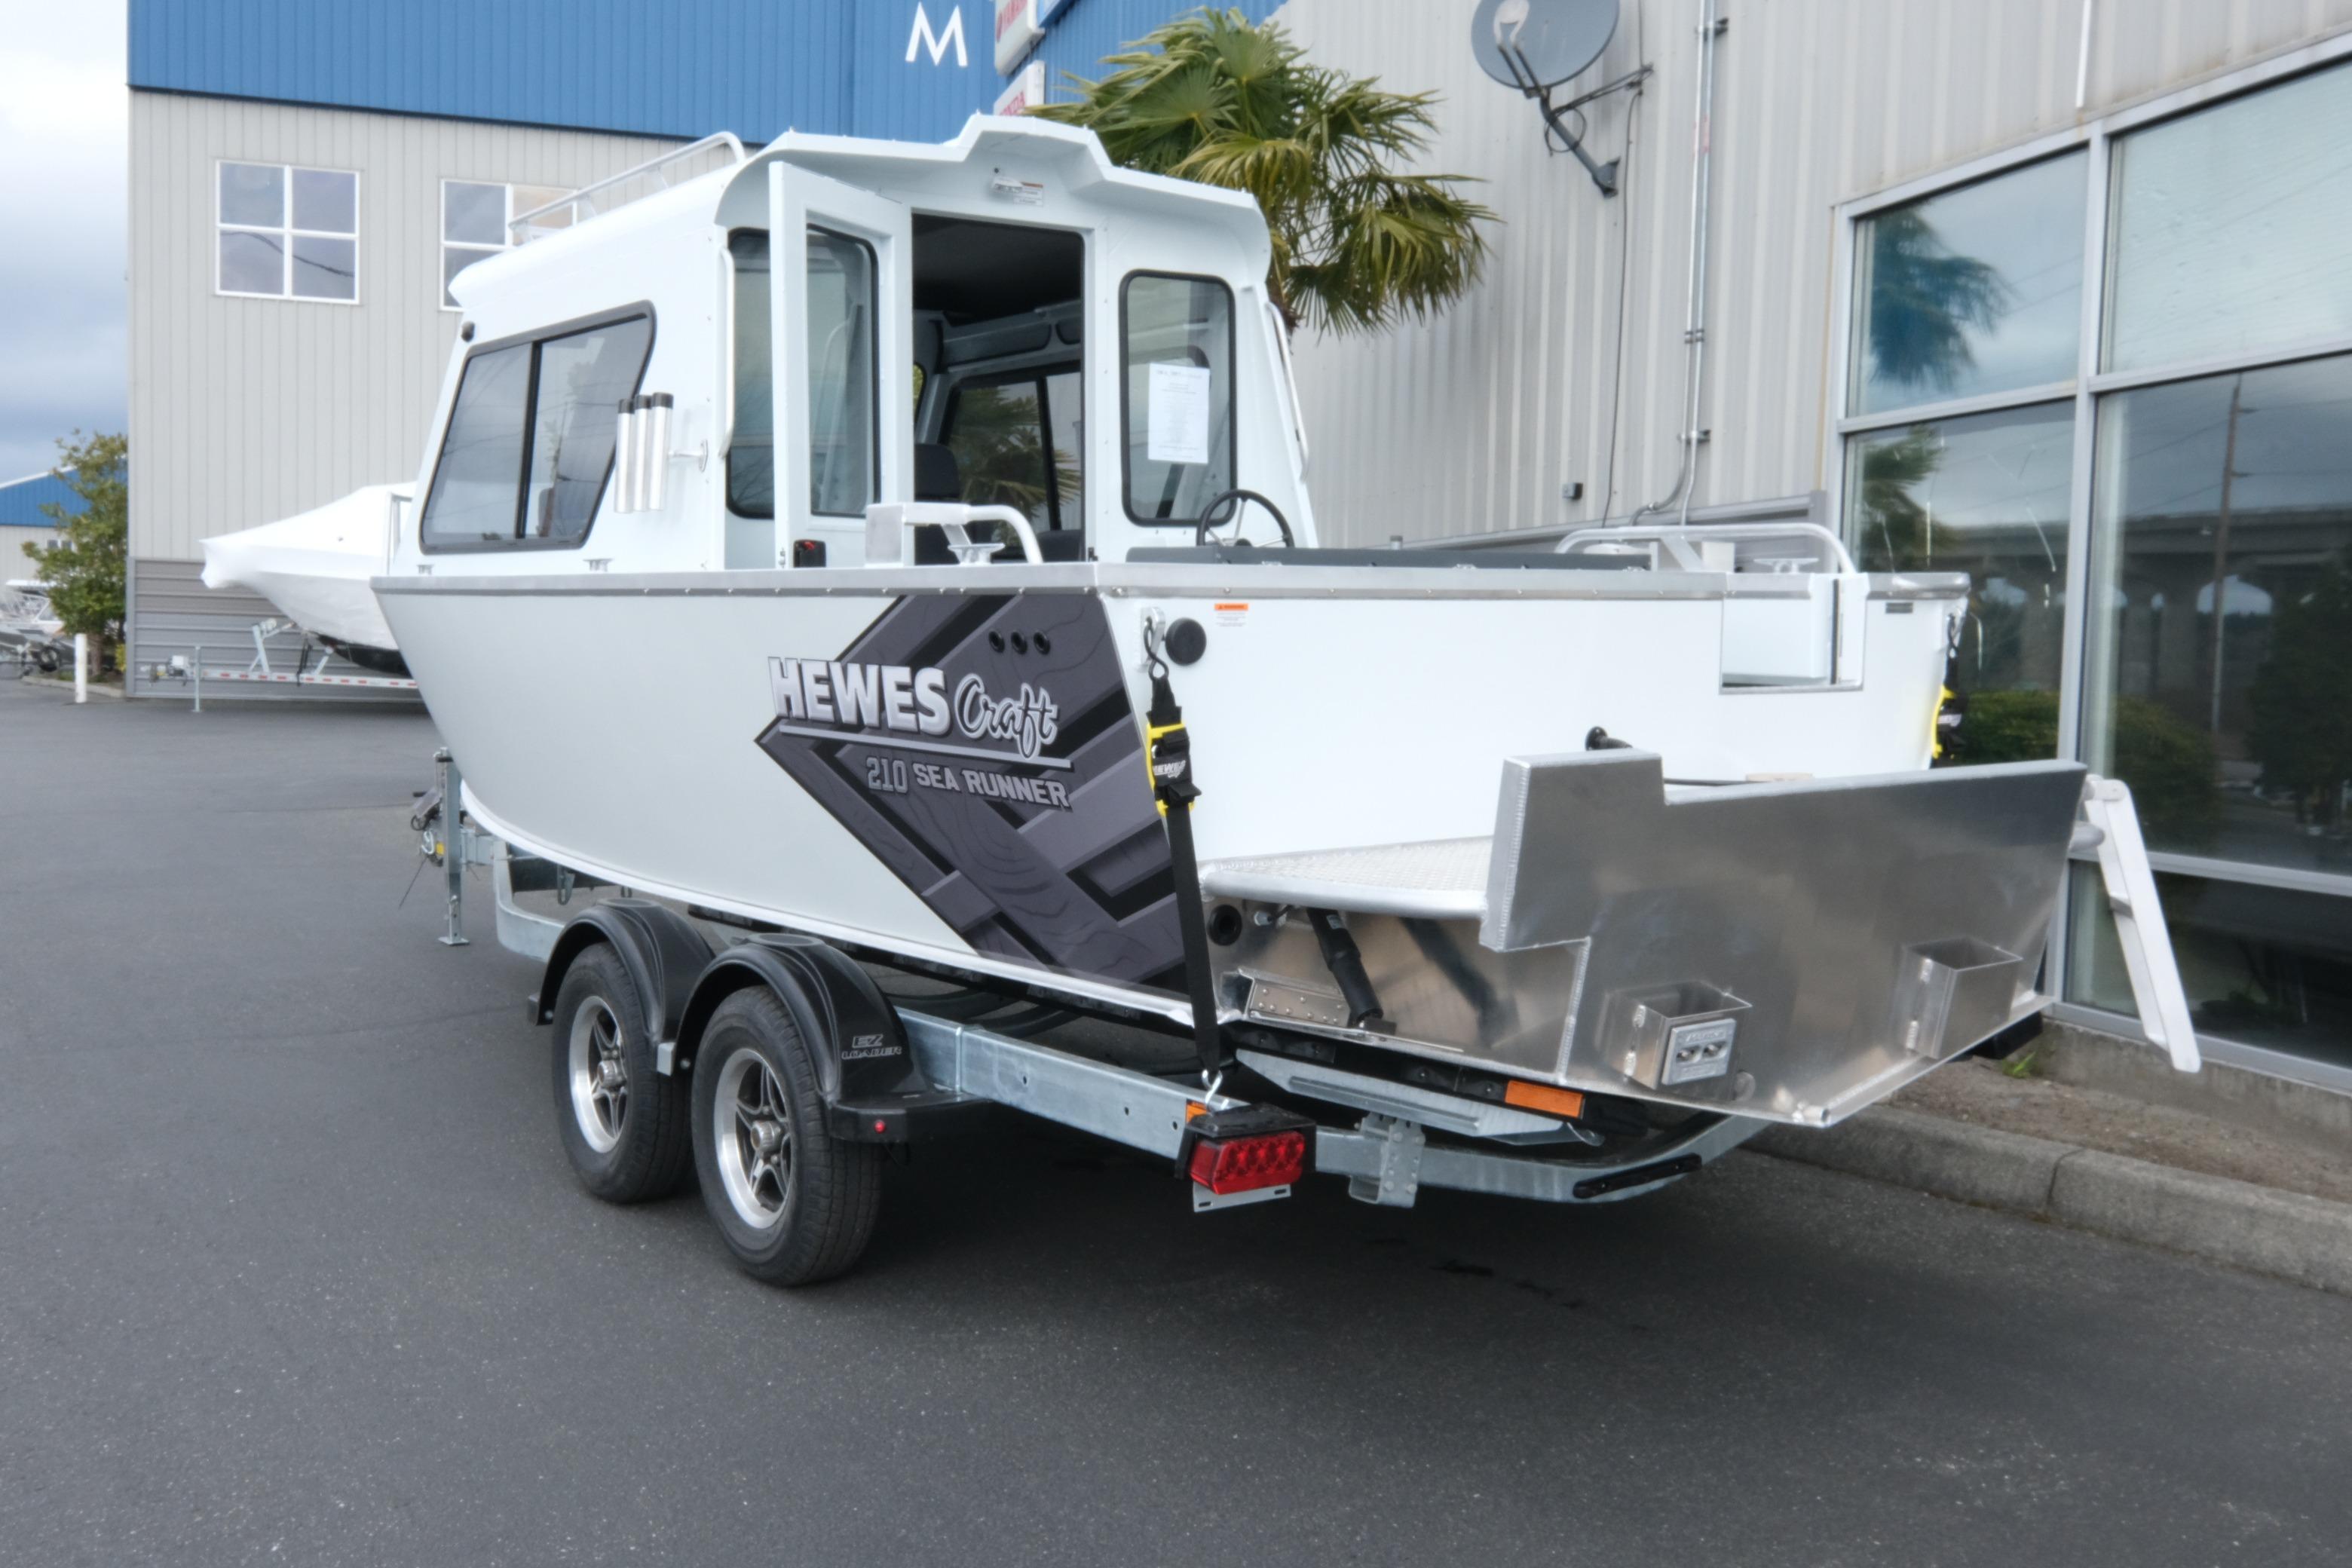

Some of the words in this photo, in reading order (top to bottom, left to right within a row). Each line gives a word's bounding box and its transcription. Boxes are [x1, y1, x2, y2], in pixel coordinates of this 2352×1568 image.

[905, 1, 968, 67] M
[767, 657, 951, 736] HEWES
[954, 673, 1058, 758] Craft
[866, 757, 908, 793] 210
[912, 762, 960, 792] SEA
[960, 768, 1070, 808] RUNNER
[852, 1034, 884, 1049] EZ
